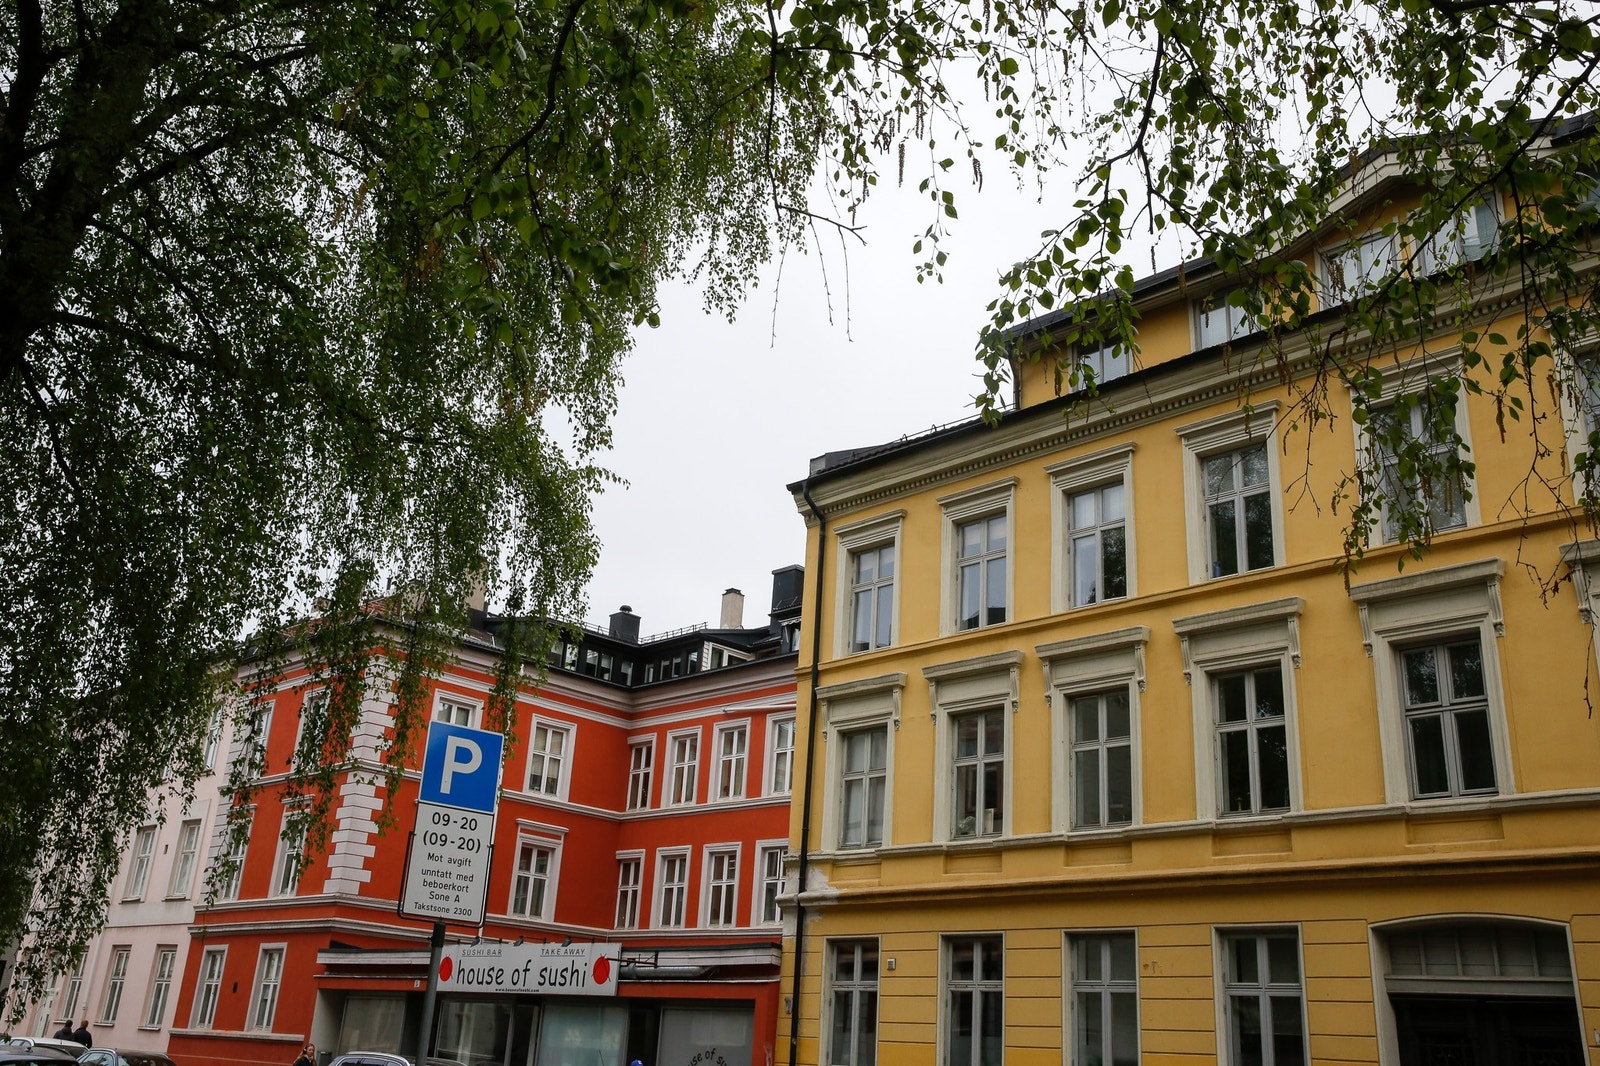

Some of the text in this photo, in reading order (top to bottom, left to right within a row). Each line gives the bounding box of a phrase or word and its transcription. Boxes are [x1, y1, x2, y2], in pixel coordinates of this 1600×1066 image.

[440, 735, 483, 795] P
[427, 852, 472, 869] Mot avgift
[421, 868, 474, 882] unntatt med
[422, 878, 469, 893] beboerkort
[429, 891, 460, 904] Sone A
[413, 902, 472, 917] Takstsone 2300
[541, 948, 585, 956] TAKE AWAY
[456, 959, 588, 987] house of sushi
[704, 1047, 717, 1061] of
